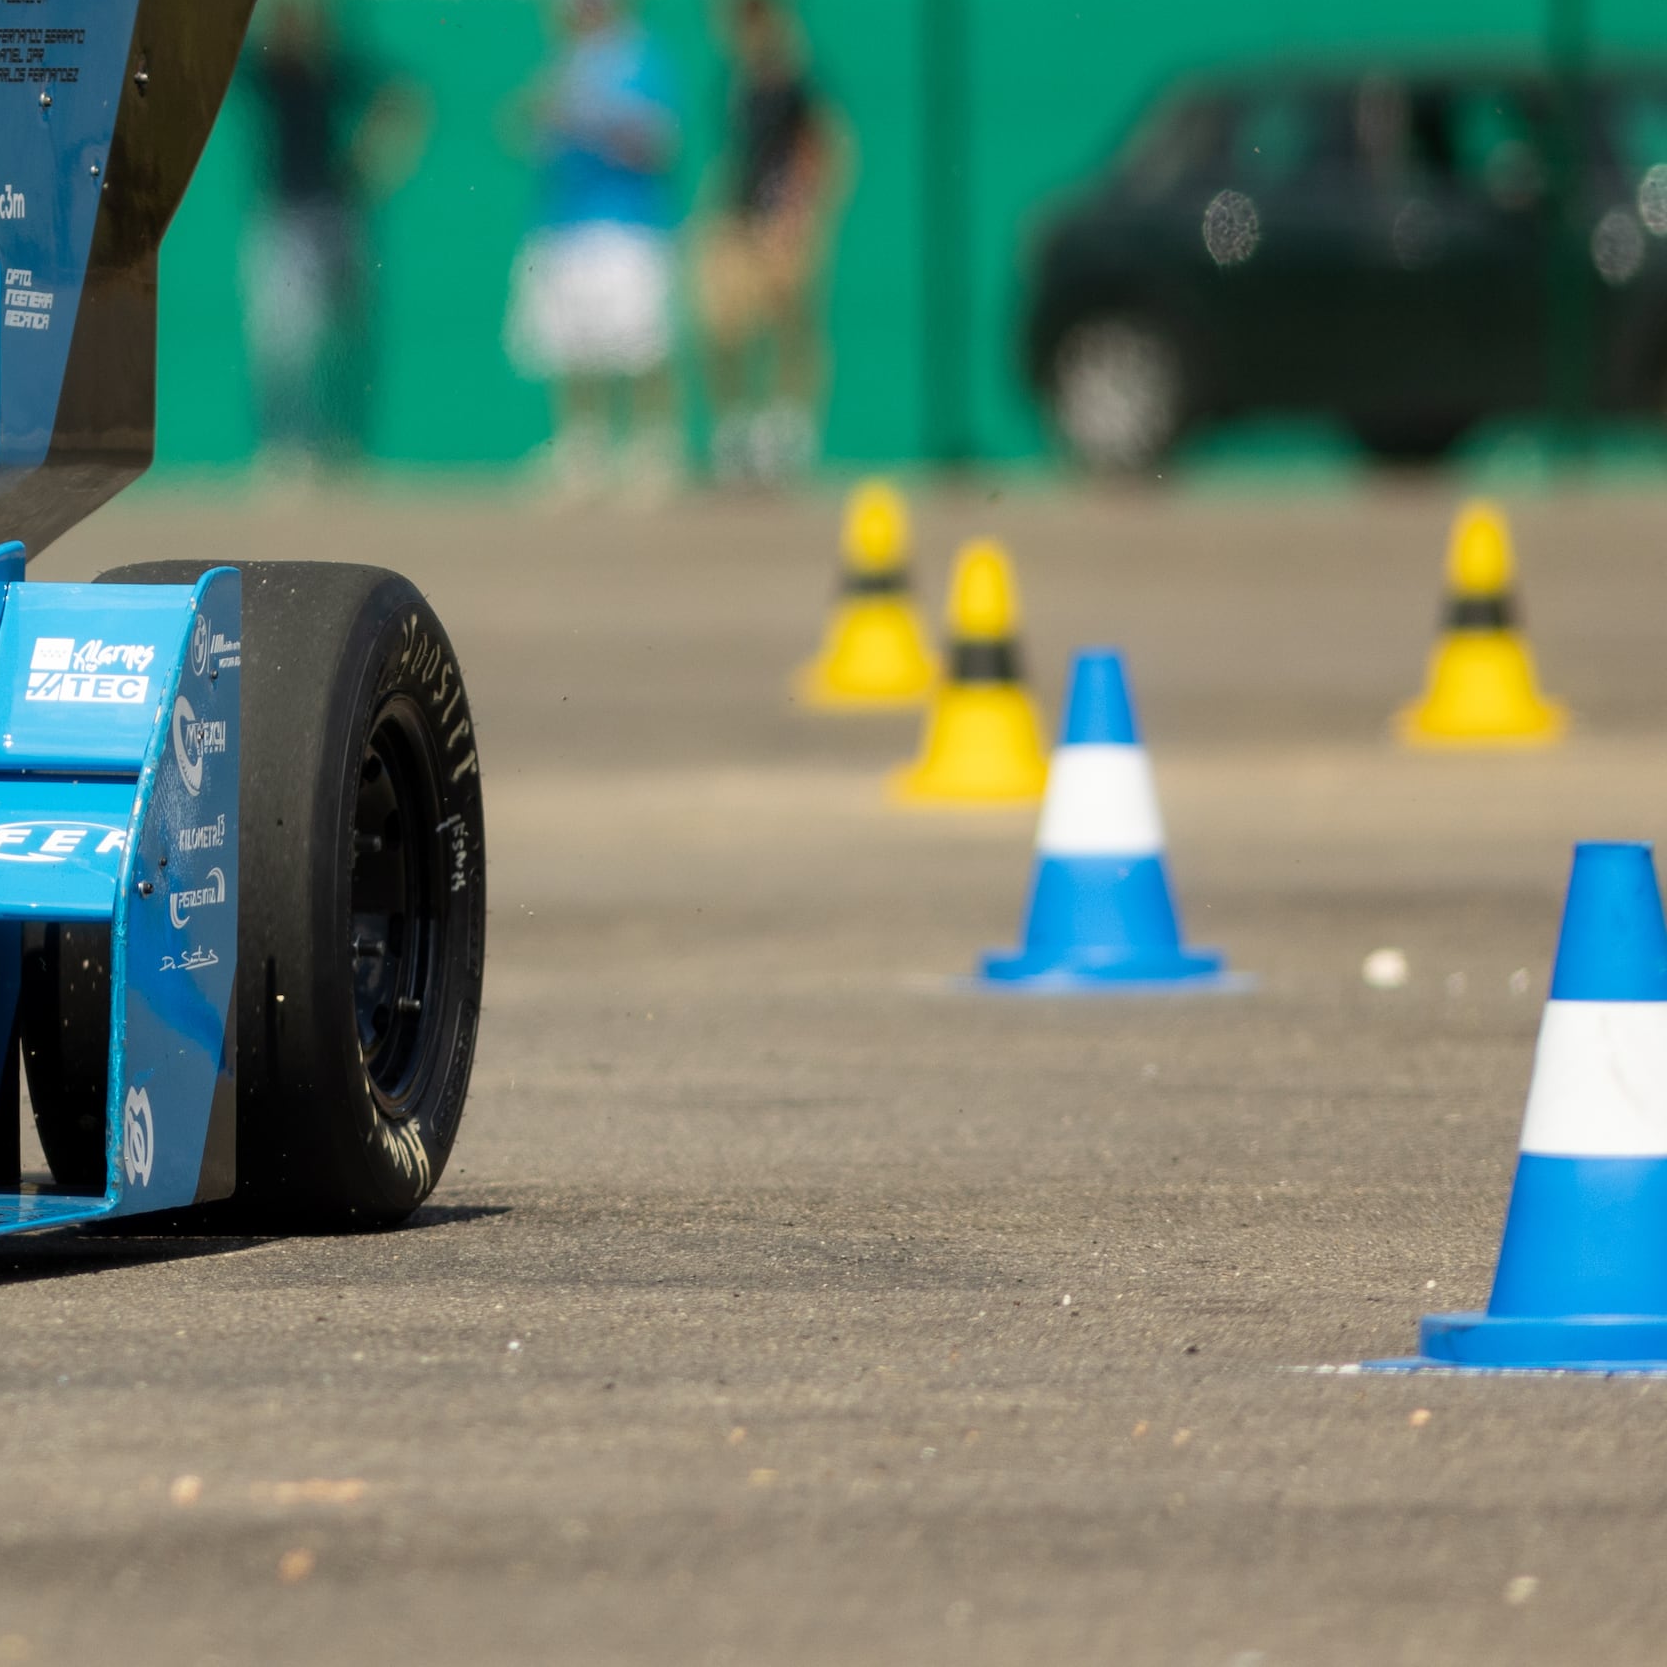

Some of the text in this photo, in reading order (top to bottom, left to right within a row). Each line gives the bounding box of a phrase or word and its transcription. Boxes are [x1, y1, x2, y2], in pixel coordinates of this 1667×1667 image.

[45, 29, 85, 44] SERRANO
[28, 67, 79, 82] FERNANDEZ
[70, 677, 141, 699] TEC
